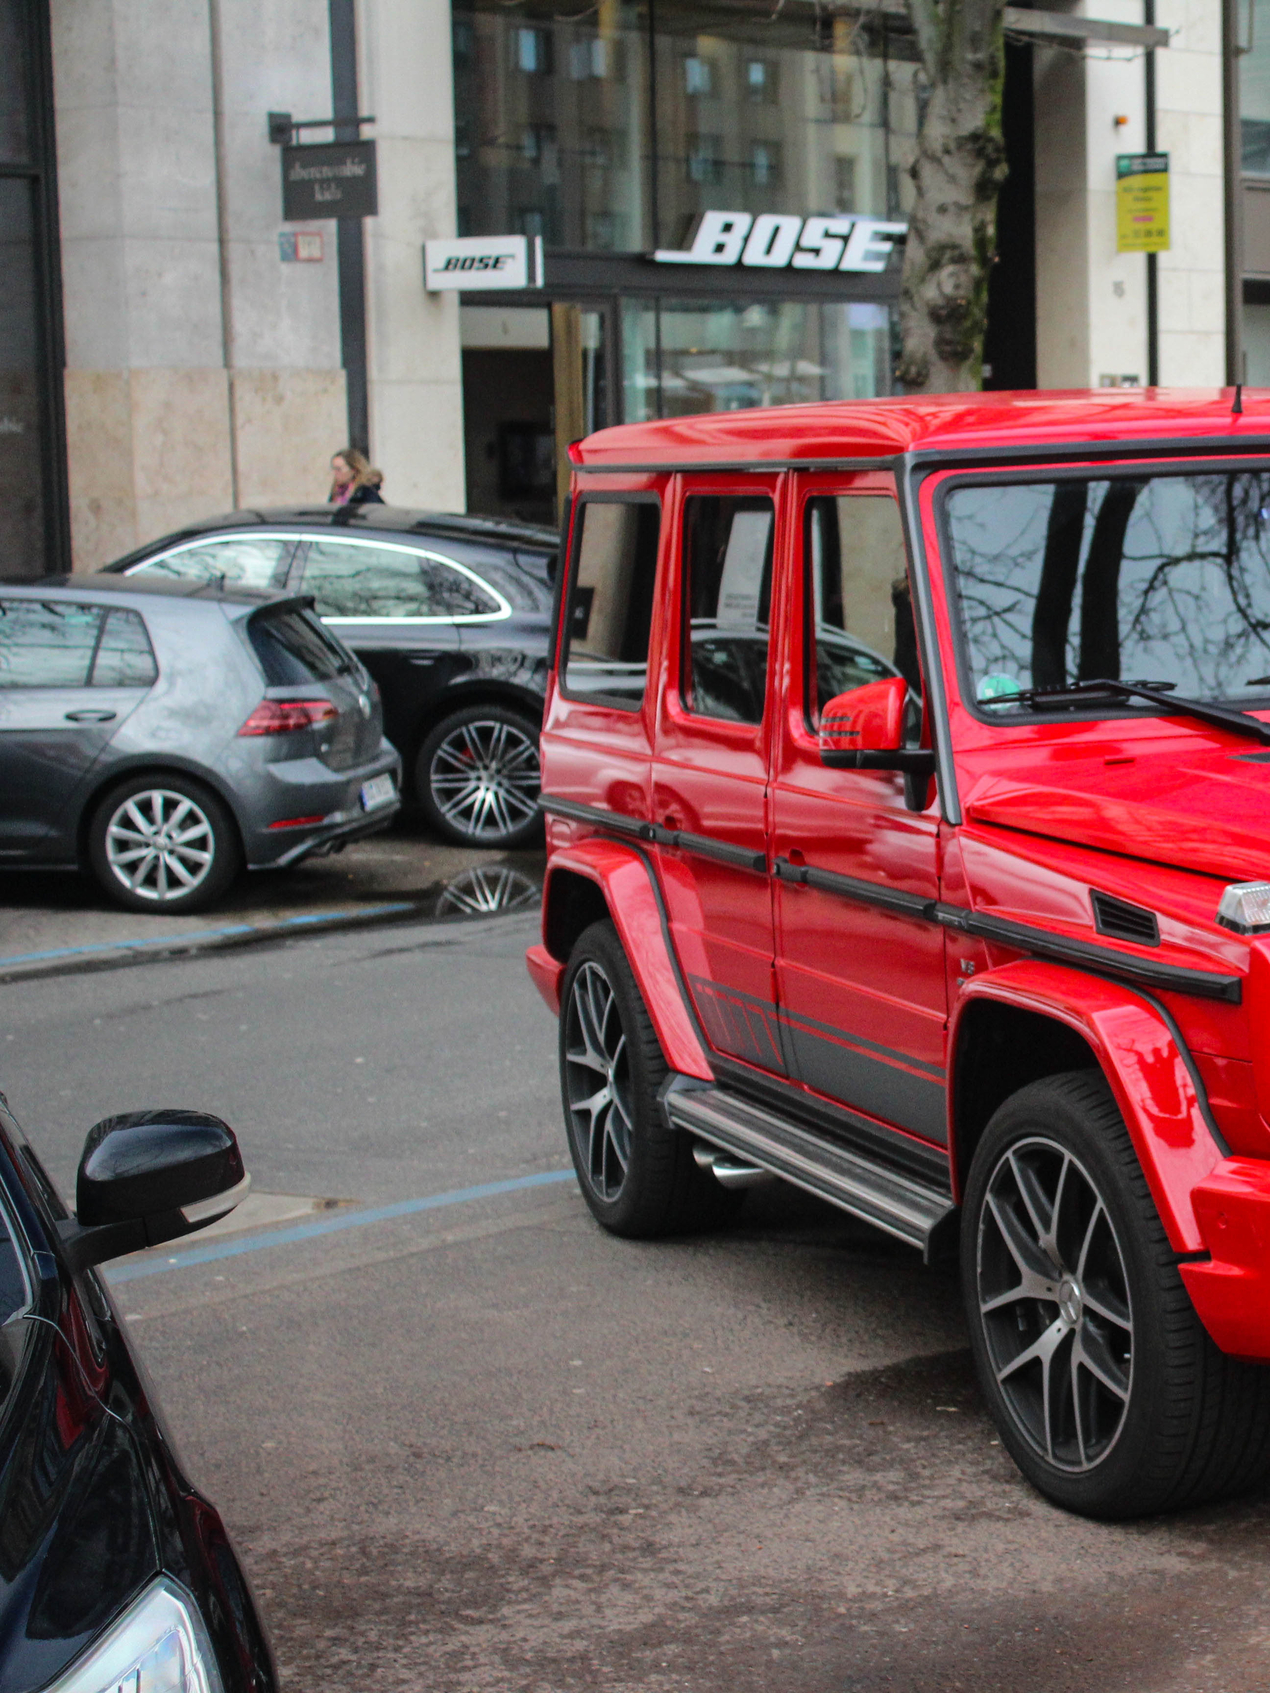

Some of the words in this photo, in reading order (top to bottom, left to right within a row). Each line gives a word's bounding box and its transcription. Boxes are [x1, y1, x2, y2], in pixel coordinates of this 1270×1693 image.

[314, 182, 343, 201] kids
[654, 210, 908, 273] BOSE
[432, 253, 515, 273] BOSE
